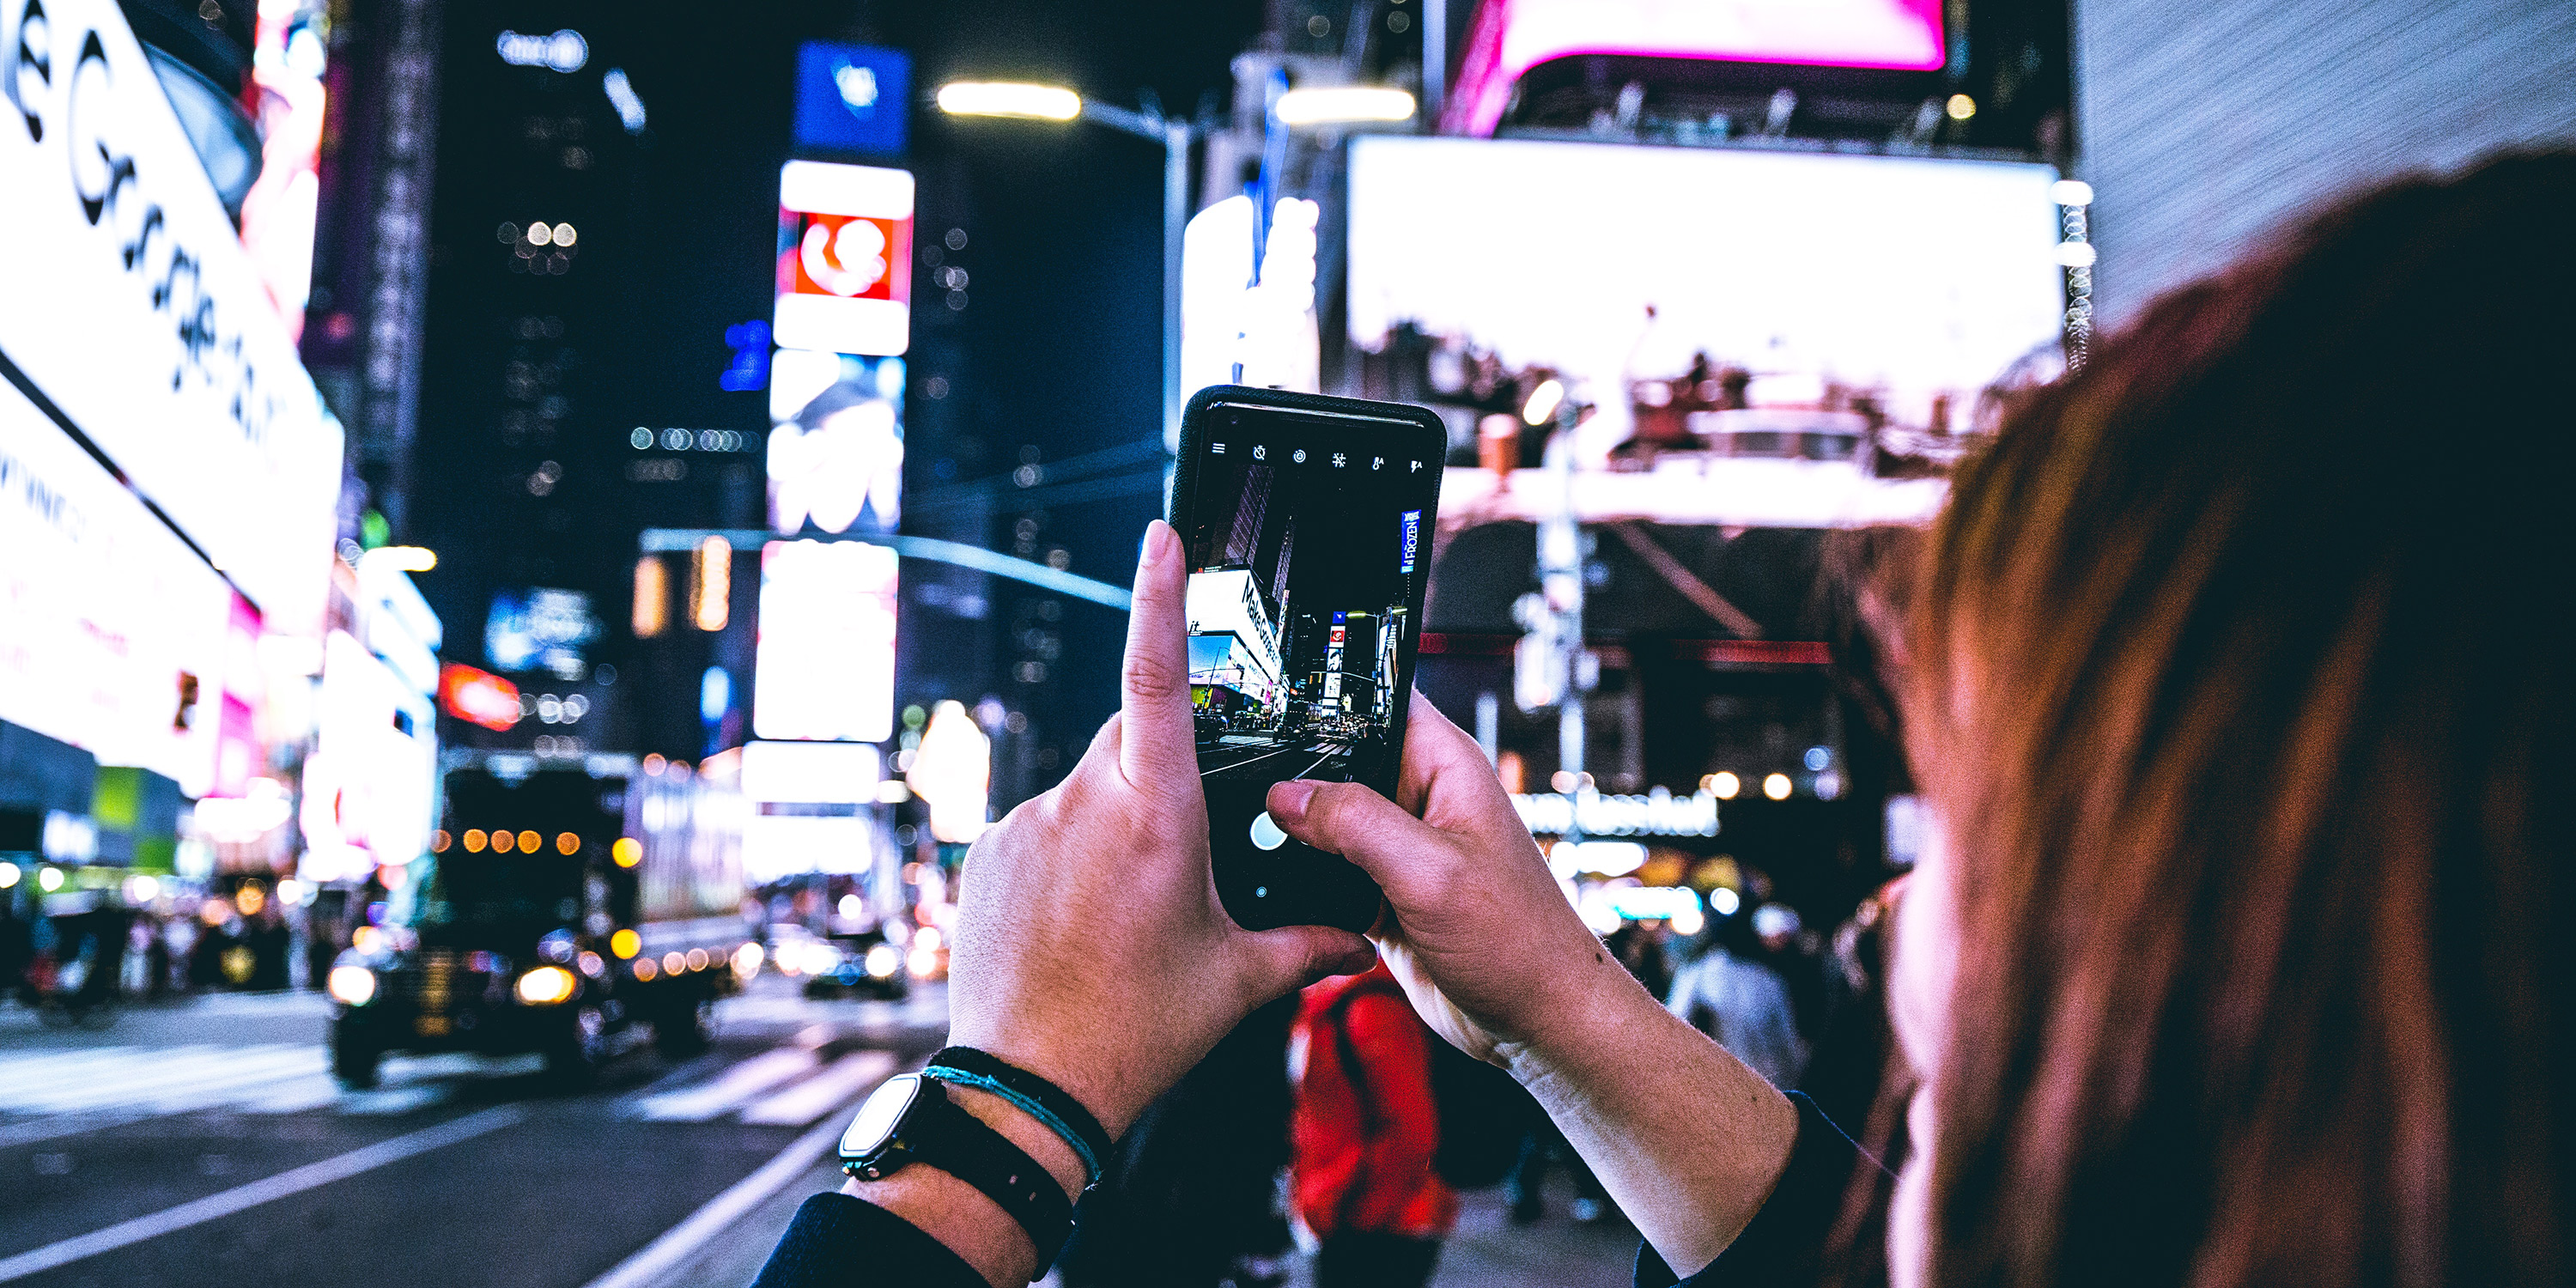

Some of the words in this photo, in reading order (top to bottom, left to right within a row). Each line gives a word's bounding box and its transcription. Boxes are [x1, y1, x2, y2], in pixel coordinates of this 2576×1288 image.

[1404, 521, 1418, 559] FROZEN
[1242, 575, 1261, 632] Make
[1188, 620, 1201, 633] it
